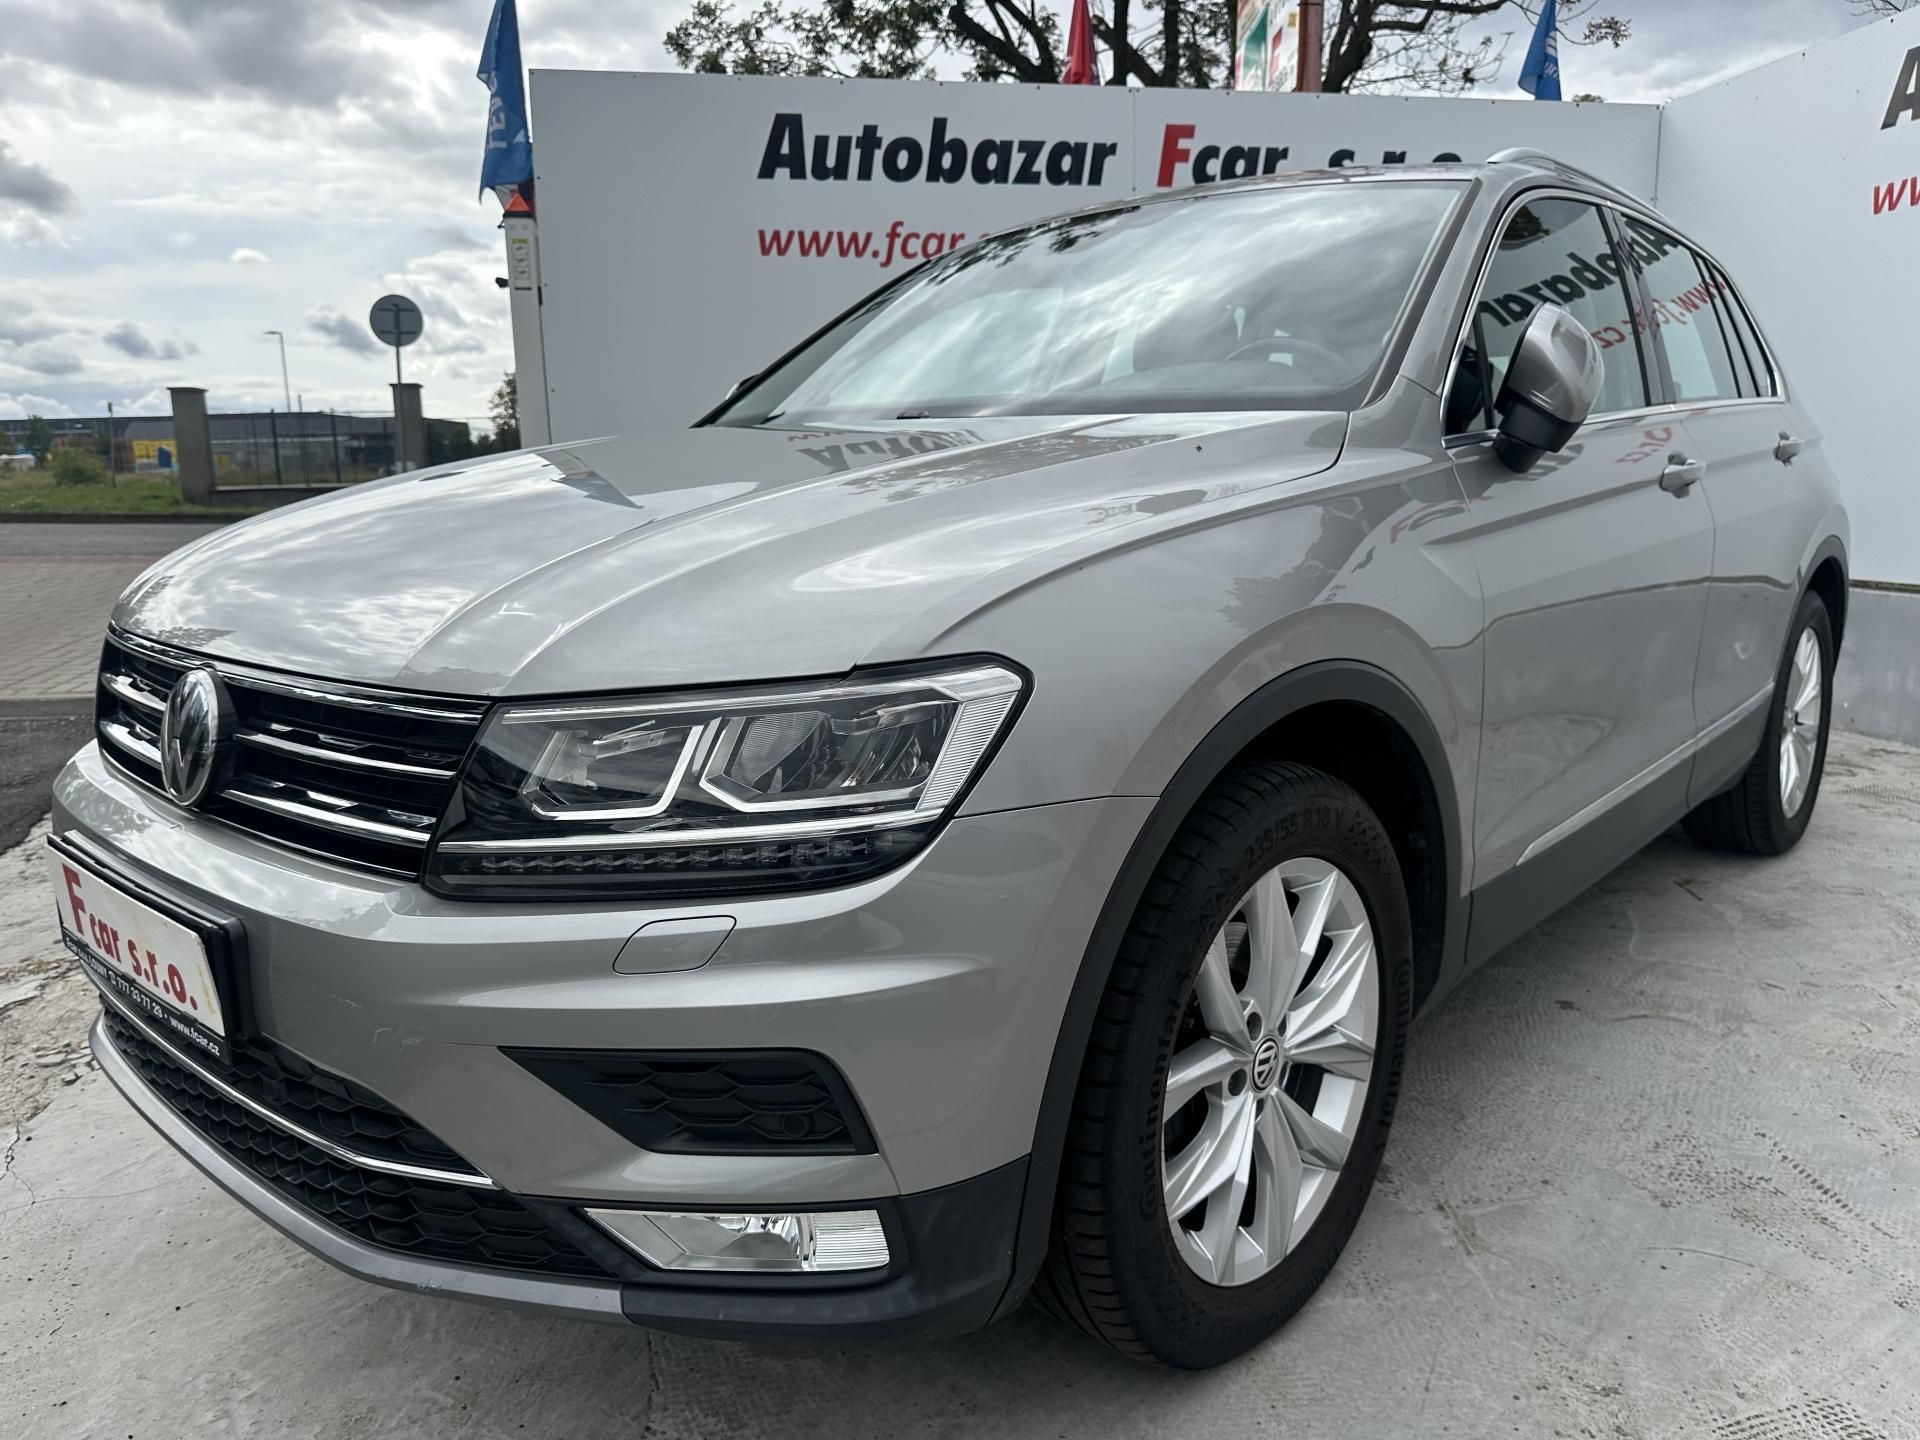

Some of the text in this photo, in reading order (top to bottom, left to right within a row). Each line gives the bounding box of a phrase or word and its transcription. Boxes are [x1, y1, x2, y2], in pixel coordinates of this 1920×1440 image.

[757, 113, 1289, 187] Autobazar Fcar
[127, 939, 198, 1011] s.r.o.
